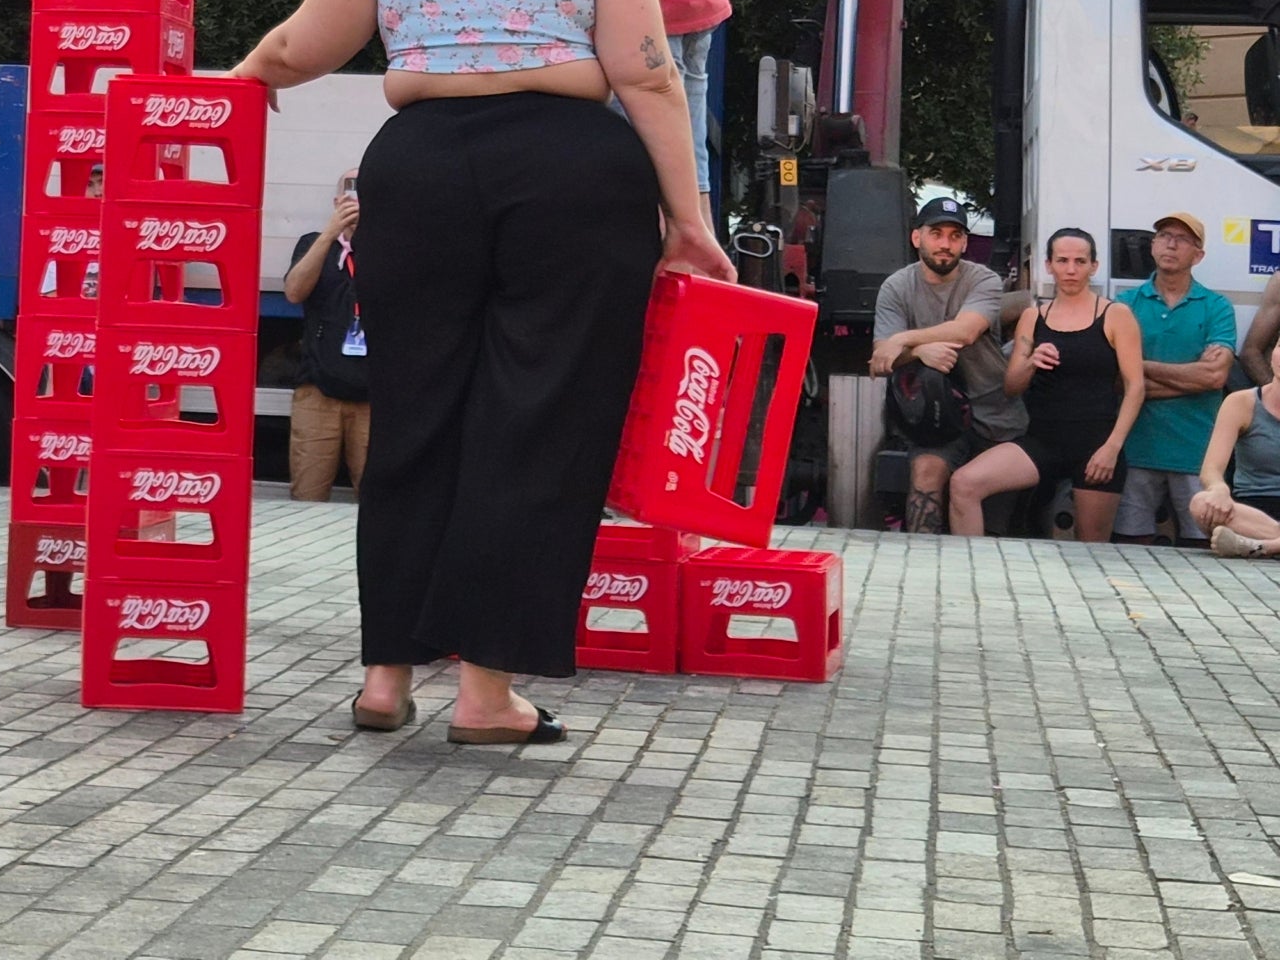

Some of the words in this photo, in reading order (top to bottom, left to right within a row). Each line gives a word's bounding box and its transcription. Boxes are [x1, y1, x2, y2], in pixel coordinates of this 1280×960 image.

[58, 23, 130, 50] Coca-Cola
[142, 97, 231, 128] Coca-Cola
[136, 221, 226, 252] Coca-Cola
[130, 343, 220, 376] Coca-Cola
[669, 348, 719, 464] Coca-Cola
[130, 471, 221, 503] Coca-Cola
[584, 573, 648, 601] Coca-Co
[711, 580, 791, 609] Coca-Cola
[119, 599, 210, 630] Coca-Cola
